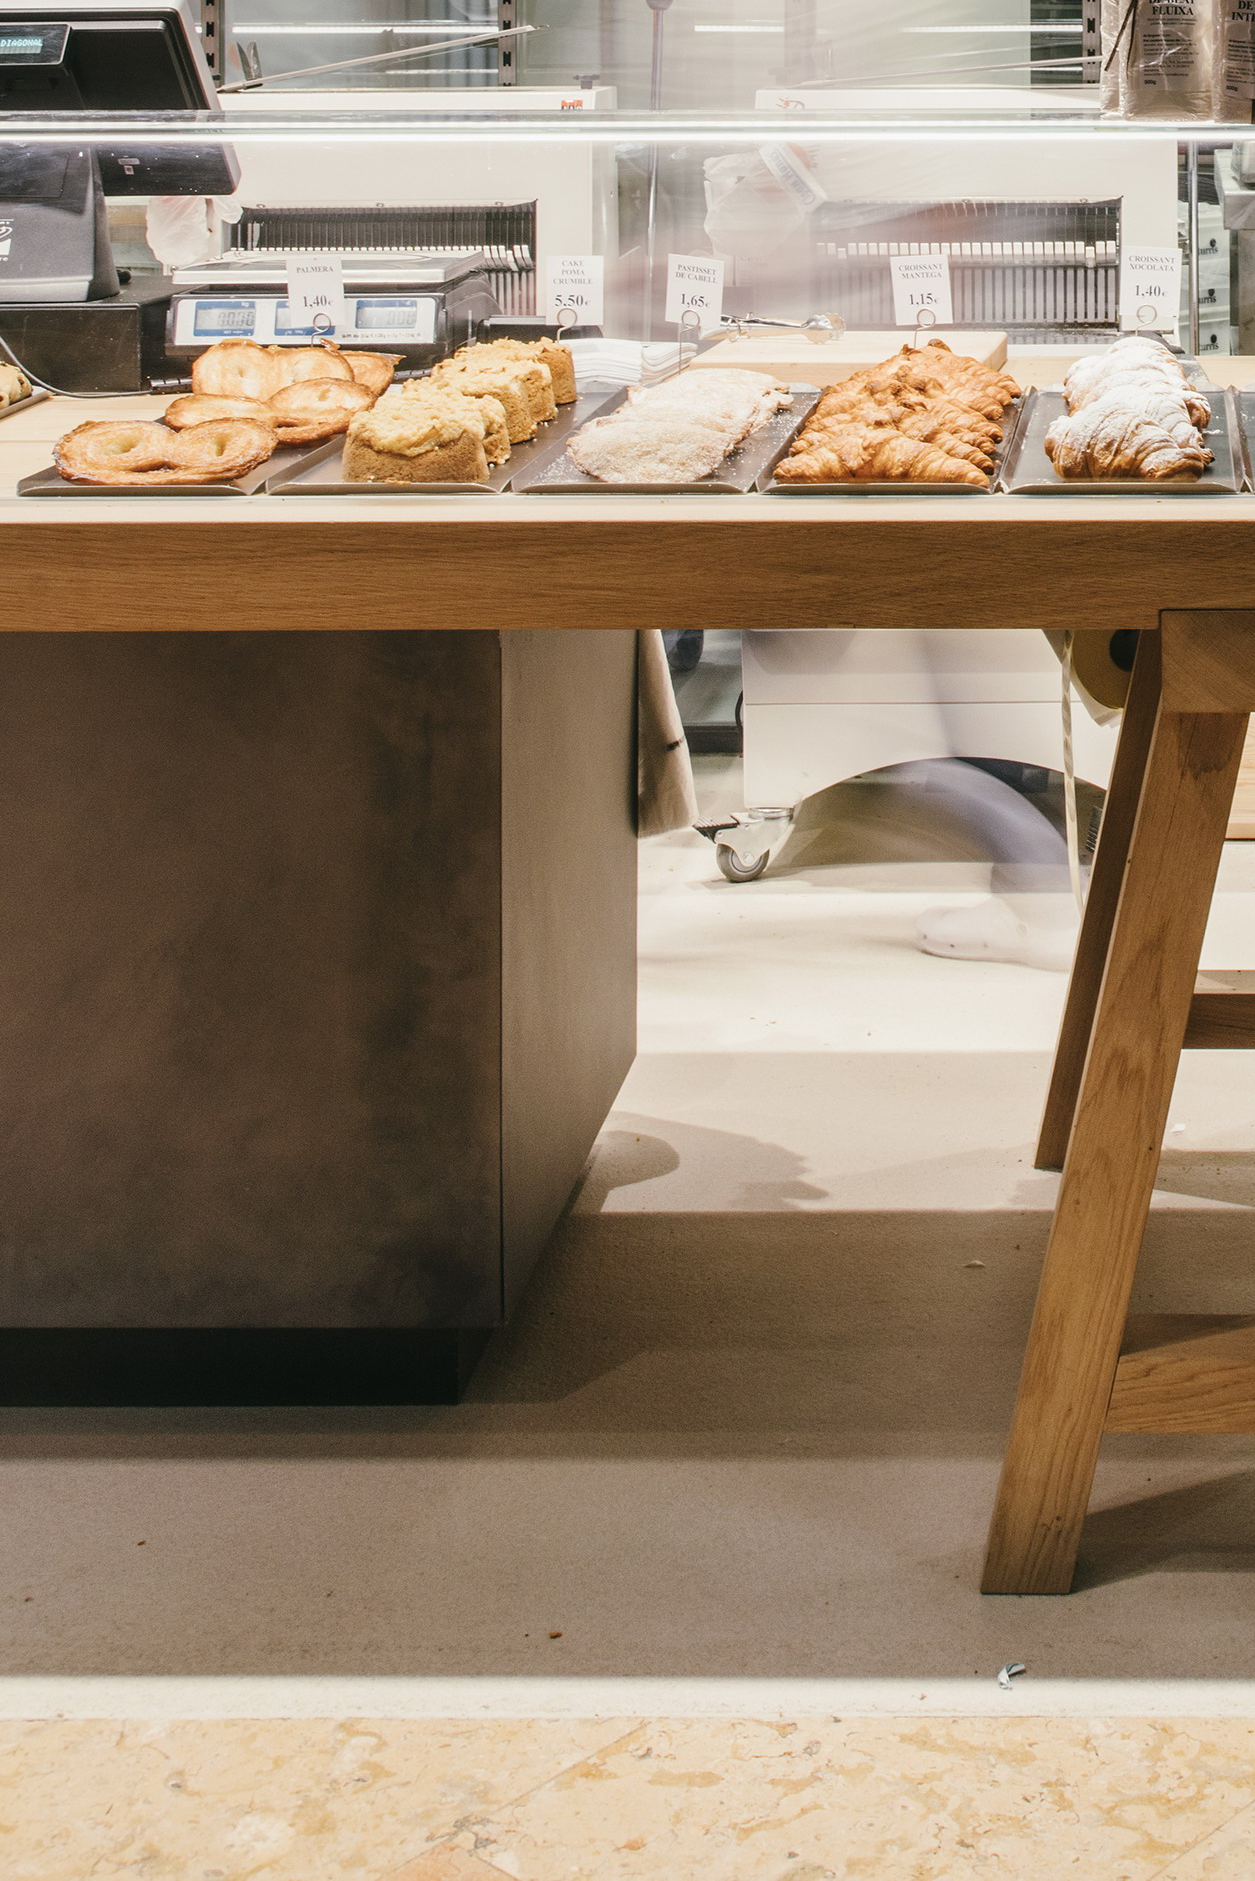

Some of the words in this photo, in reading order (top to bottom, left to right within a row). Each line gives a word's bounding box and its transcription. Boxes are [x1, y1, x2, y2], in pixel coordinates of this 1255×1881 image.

[1238, 0, 1254, 10] DE
[1152, 6, 1194, 16] FLUIXA
[0, 38, 44, 47] DIAGONAL
[1199, 247, 1219, 255] urris
[562, 259, 585, 267] CAKE
[1129, 255, 1175, 264] CROISSANT
[296, 265, 334, 274] PALMERA
[561, 268, 585, 276] POMA
[678, 264, 717, 276] PASTISSET
[898, 263, 943, 272] CROISSANT
[1129, 263, 1175, 272] XOCOLATA
[687, 273, 718, 284] CABELL
[902, 271, 942, 279] MANTEGA
[552, 277, 593, 285] CRUMBLE
[1135, 284, 1166, 298] 1,40€
[302, 294, 334, 308] 1,40€
[554, 294, 592, 308] 5,50€
[680, 293, 711, 308] 1,65€
[909, 293, 938, 306] 1,15€
[1198, 295, 1217, 304] urris
